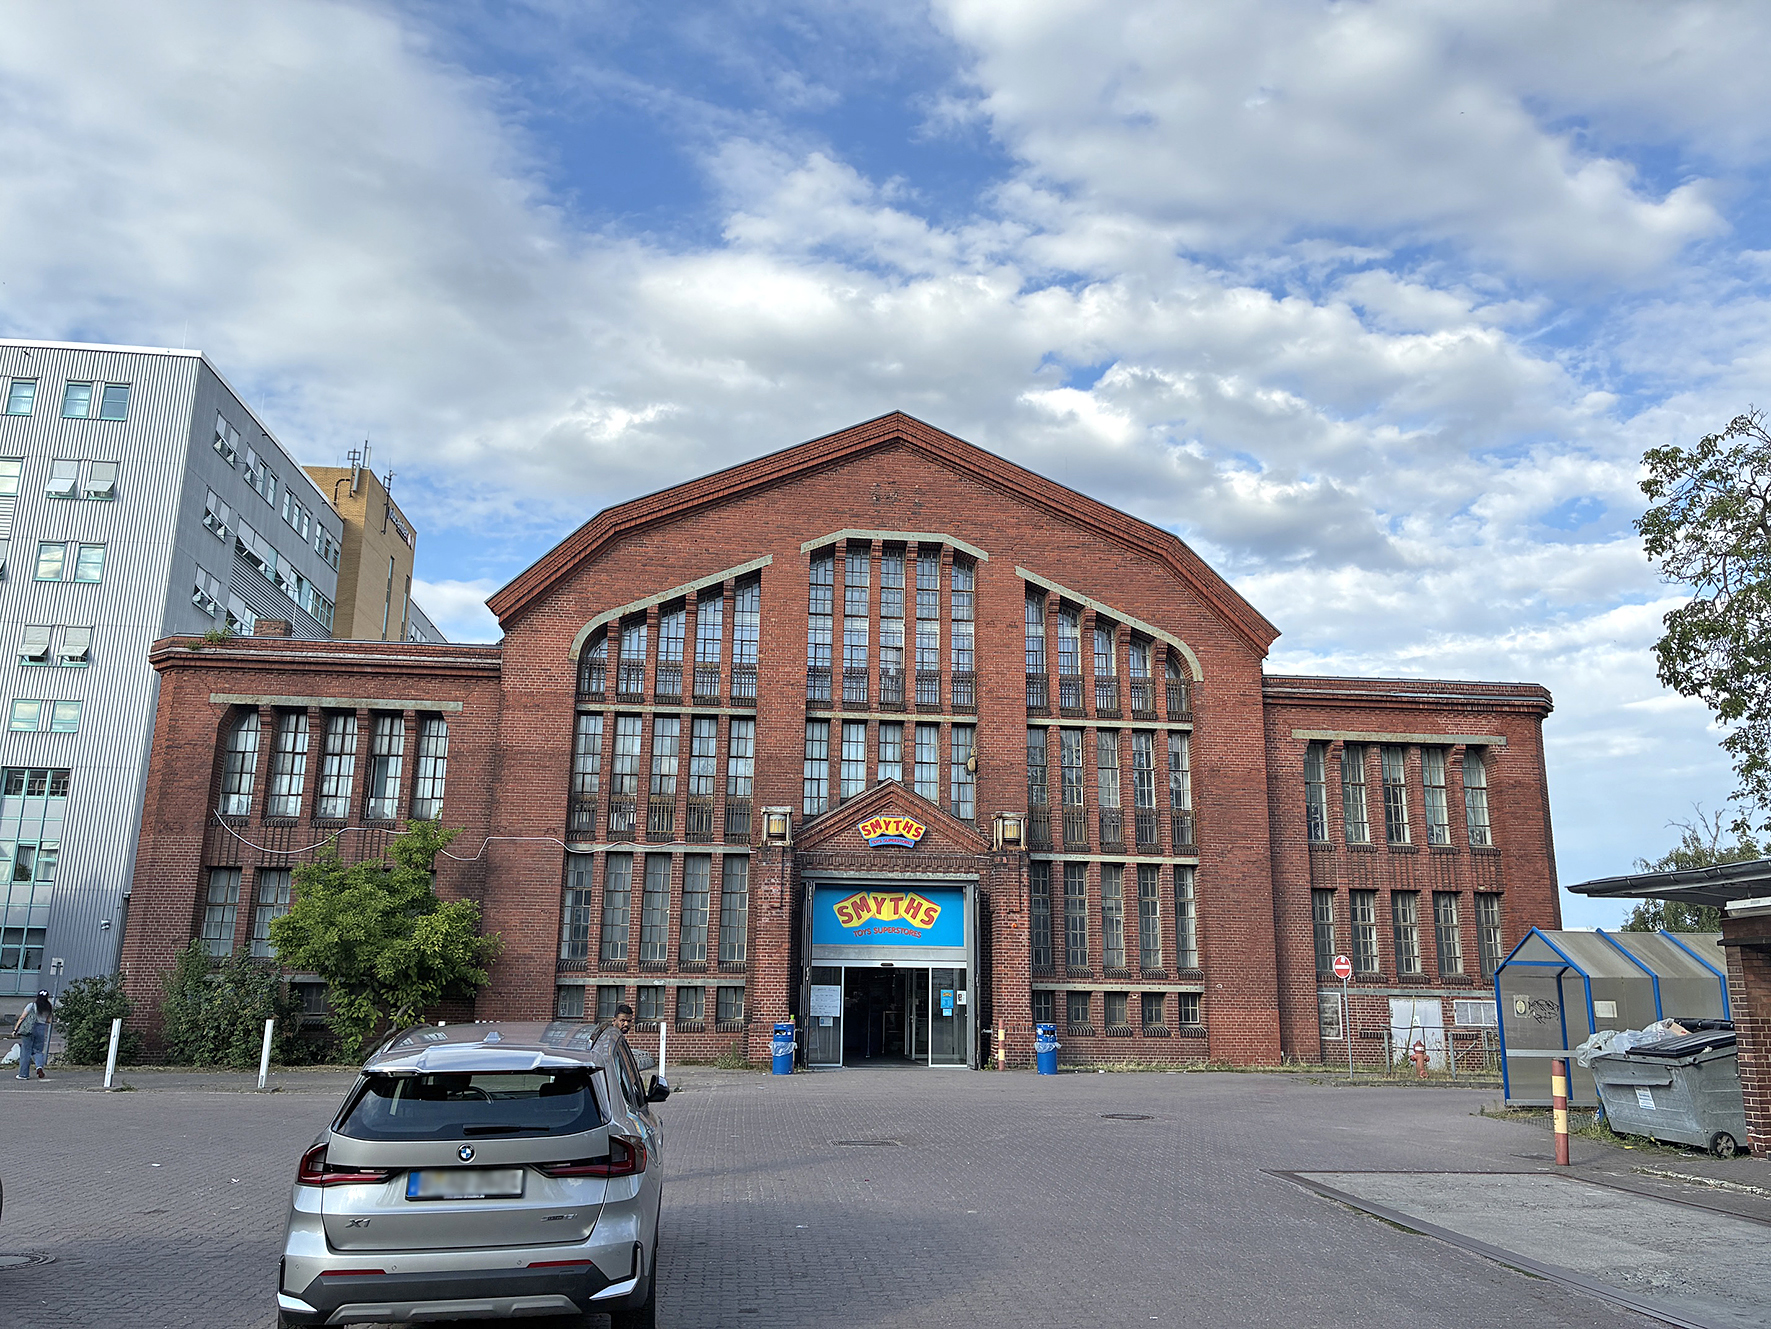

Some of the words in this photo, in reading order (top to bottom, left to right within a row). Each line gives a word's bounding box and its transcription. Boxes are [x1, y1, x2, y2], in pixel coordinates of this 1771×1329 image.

[861, 819, 923, 838] SMYTHS
[837, 895, 938, 926] SMYTHS
[853, 928, 872, 938] TOYS
[873, 926, 922, 939] SUPERSTORES
[345, 1218, 371, 1228] X1
